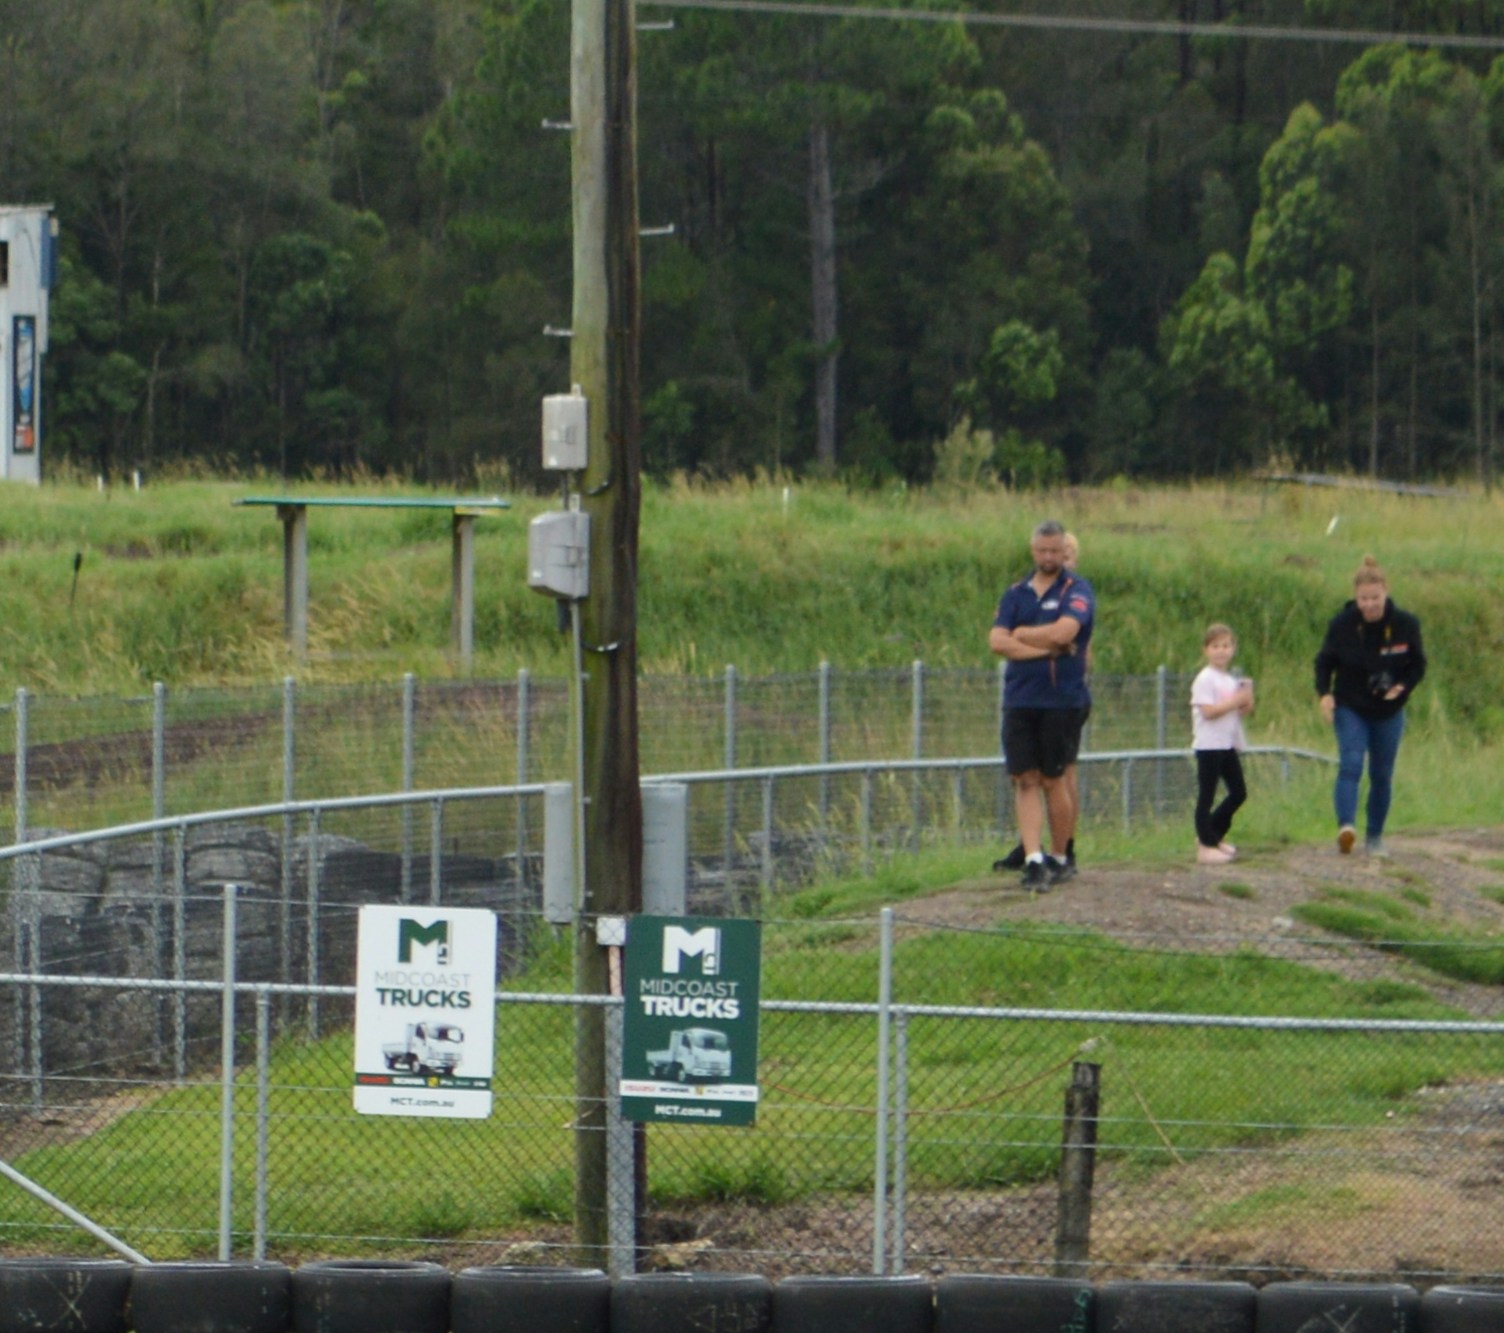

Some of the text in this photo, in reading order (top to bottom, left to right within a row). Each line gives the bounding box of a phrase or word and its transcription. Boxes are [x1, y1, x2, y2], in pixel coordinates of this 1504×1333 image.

[374, 971, 471, 988] MIDCOAST
[640, 979, 739, 997] MIDCOAST
[375, 988, 472, 1009] TRUCKS
[640, 995, 740, 1019] TRUCKS
[390, 1097, 455, 1108] MCT.com.au
